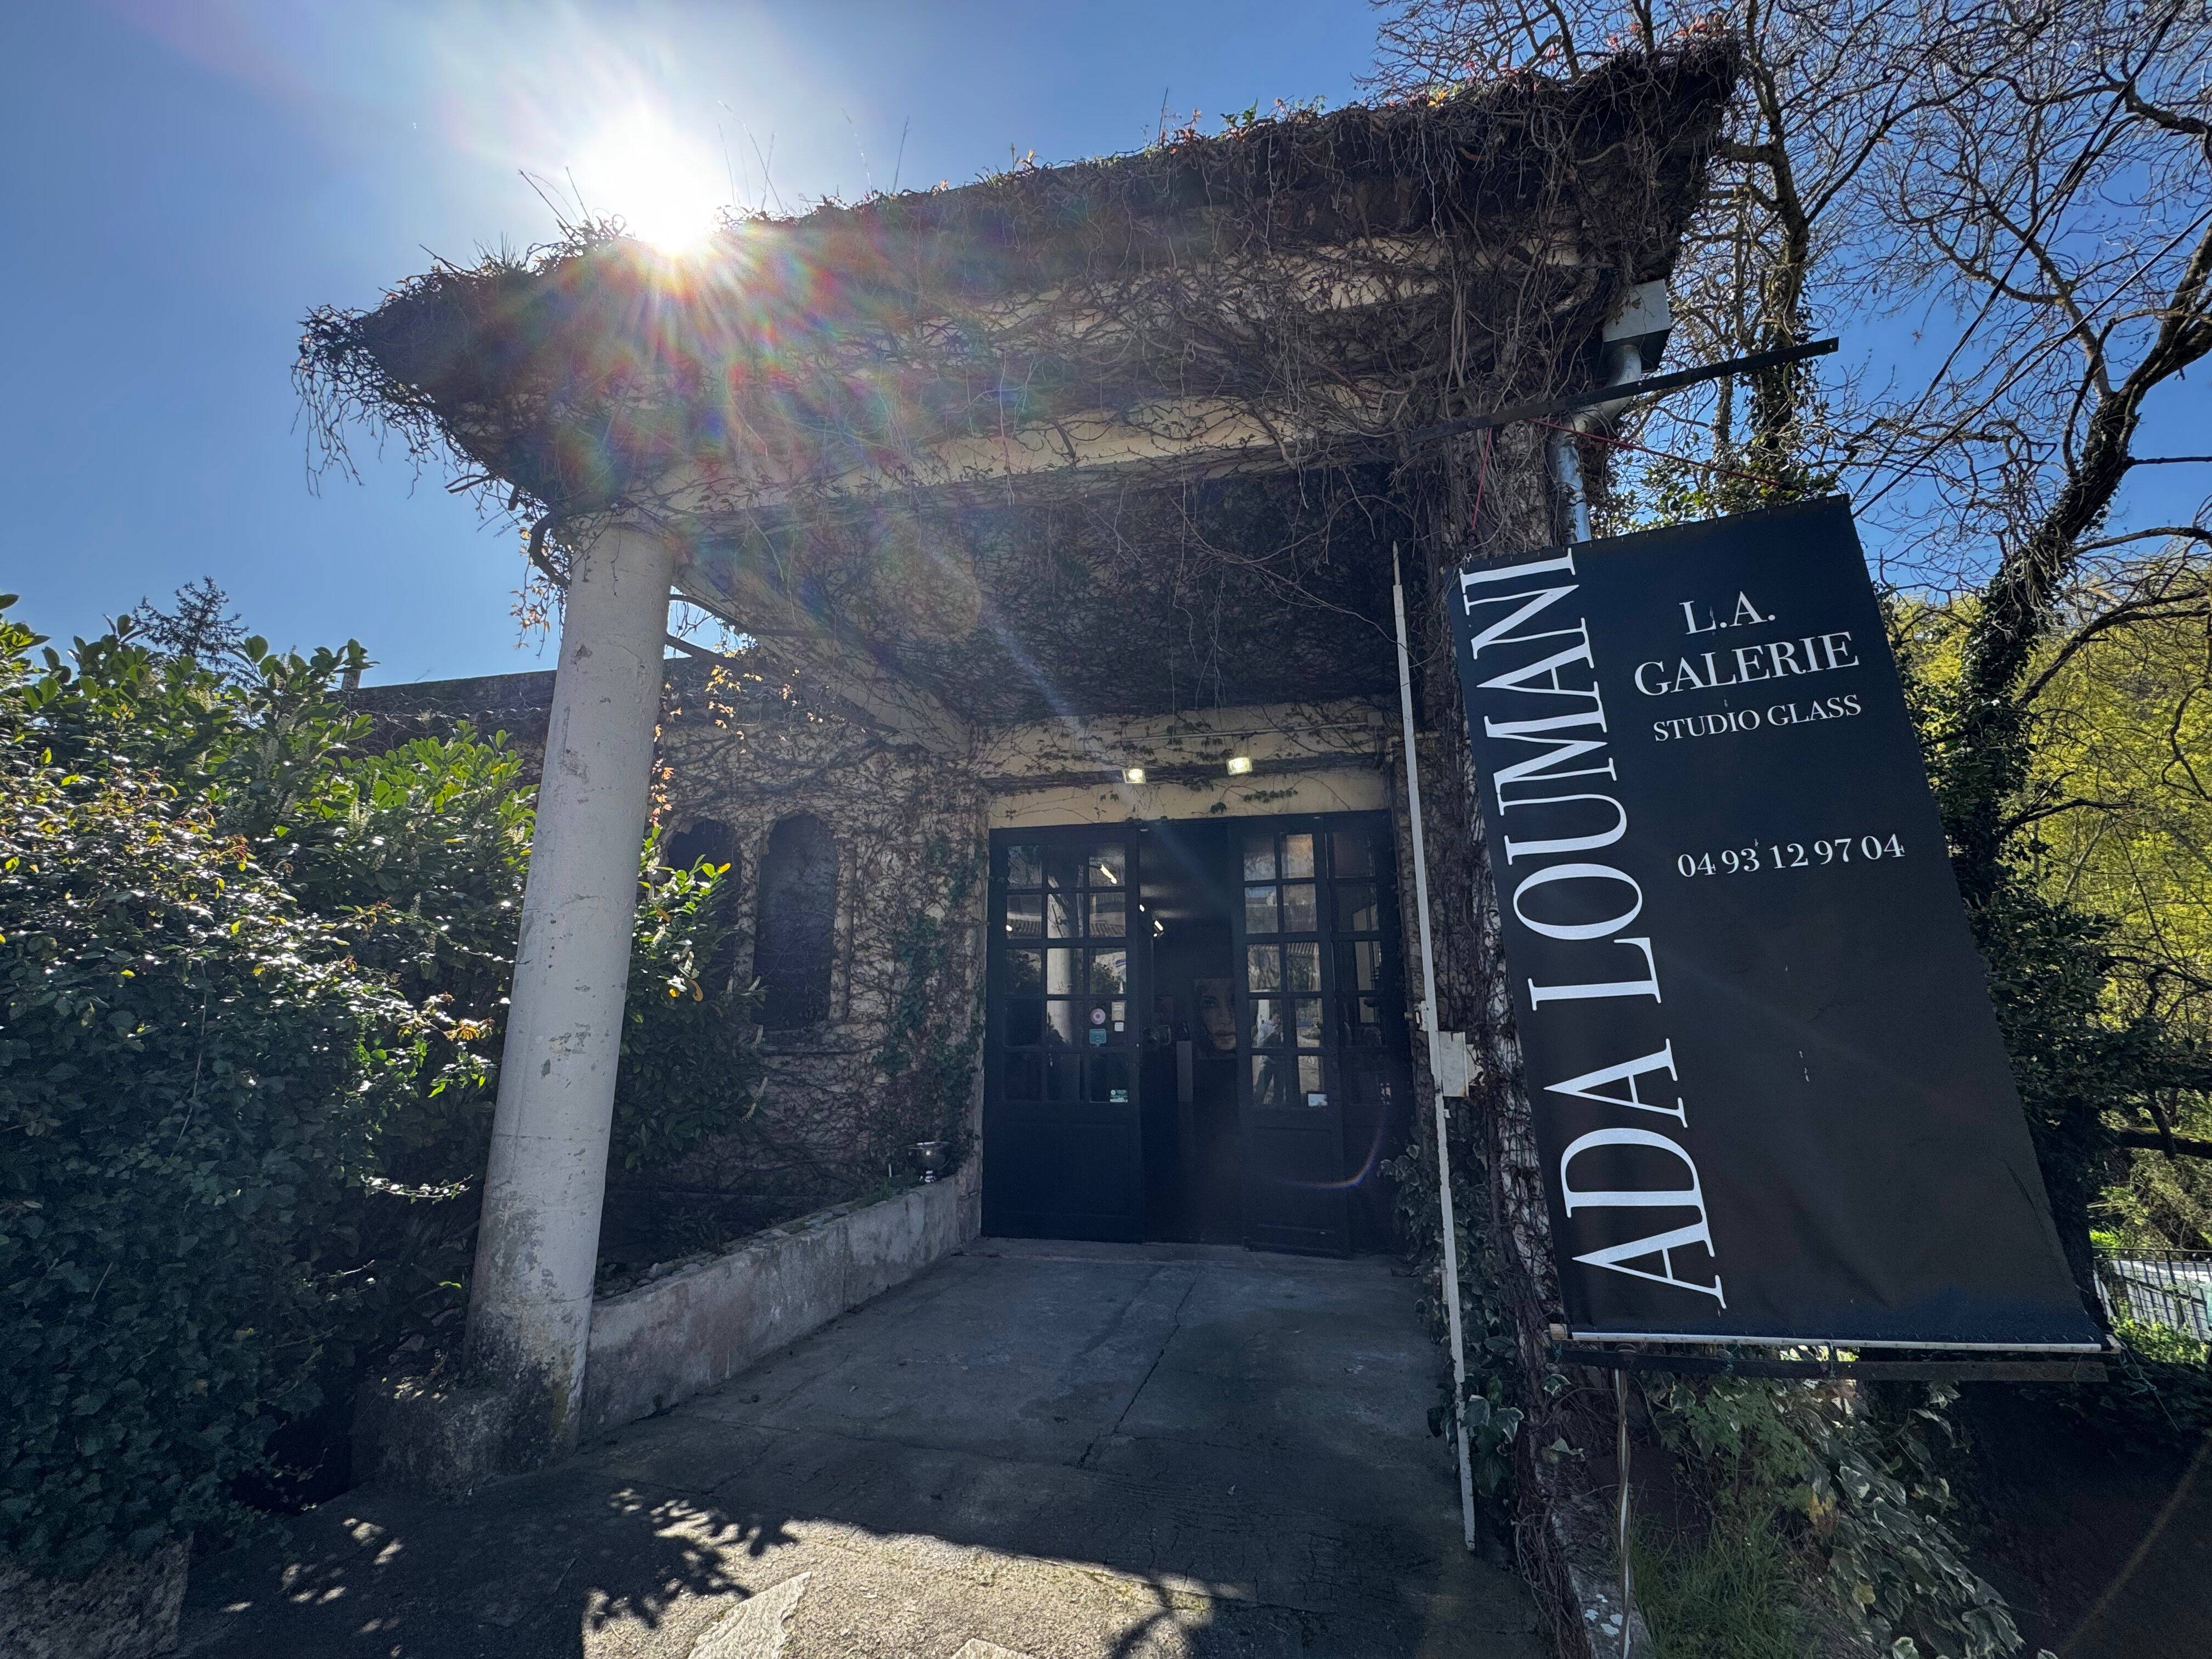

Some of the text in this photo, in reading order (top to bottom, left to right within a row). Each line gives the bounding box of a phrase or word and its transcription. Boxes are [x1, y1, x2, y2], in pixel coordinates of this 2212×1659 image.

[1678, 591, 1776, 635] L.A.
[1634, 631, 1860, 696] GALERIE
[1653, 693, 1862, 742] STUDIO GLASS
[1677, 833, 1906, 879] 04 93 12 97 04
[1459, 547, 1727, 1310] ADA LOUMANI
